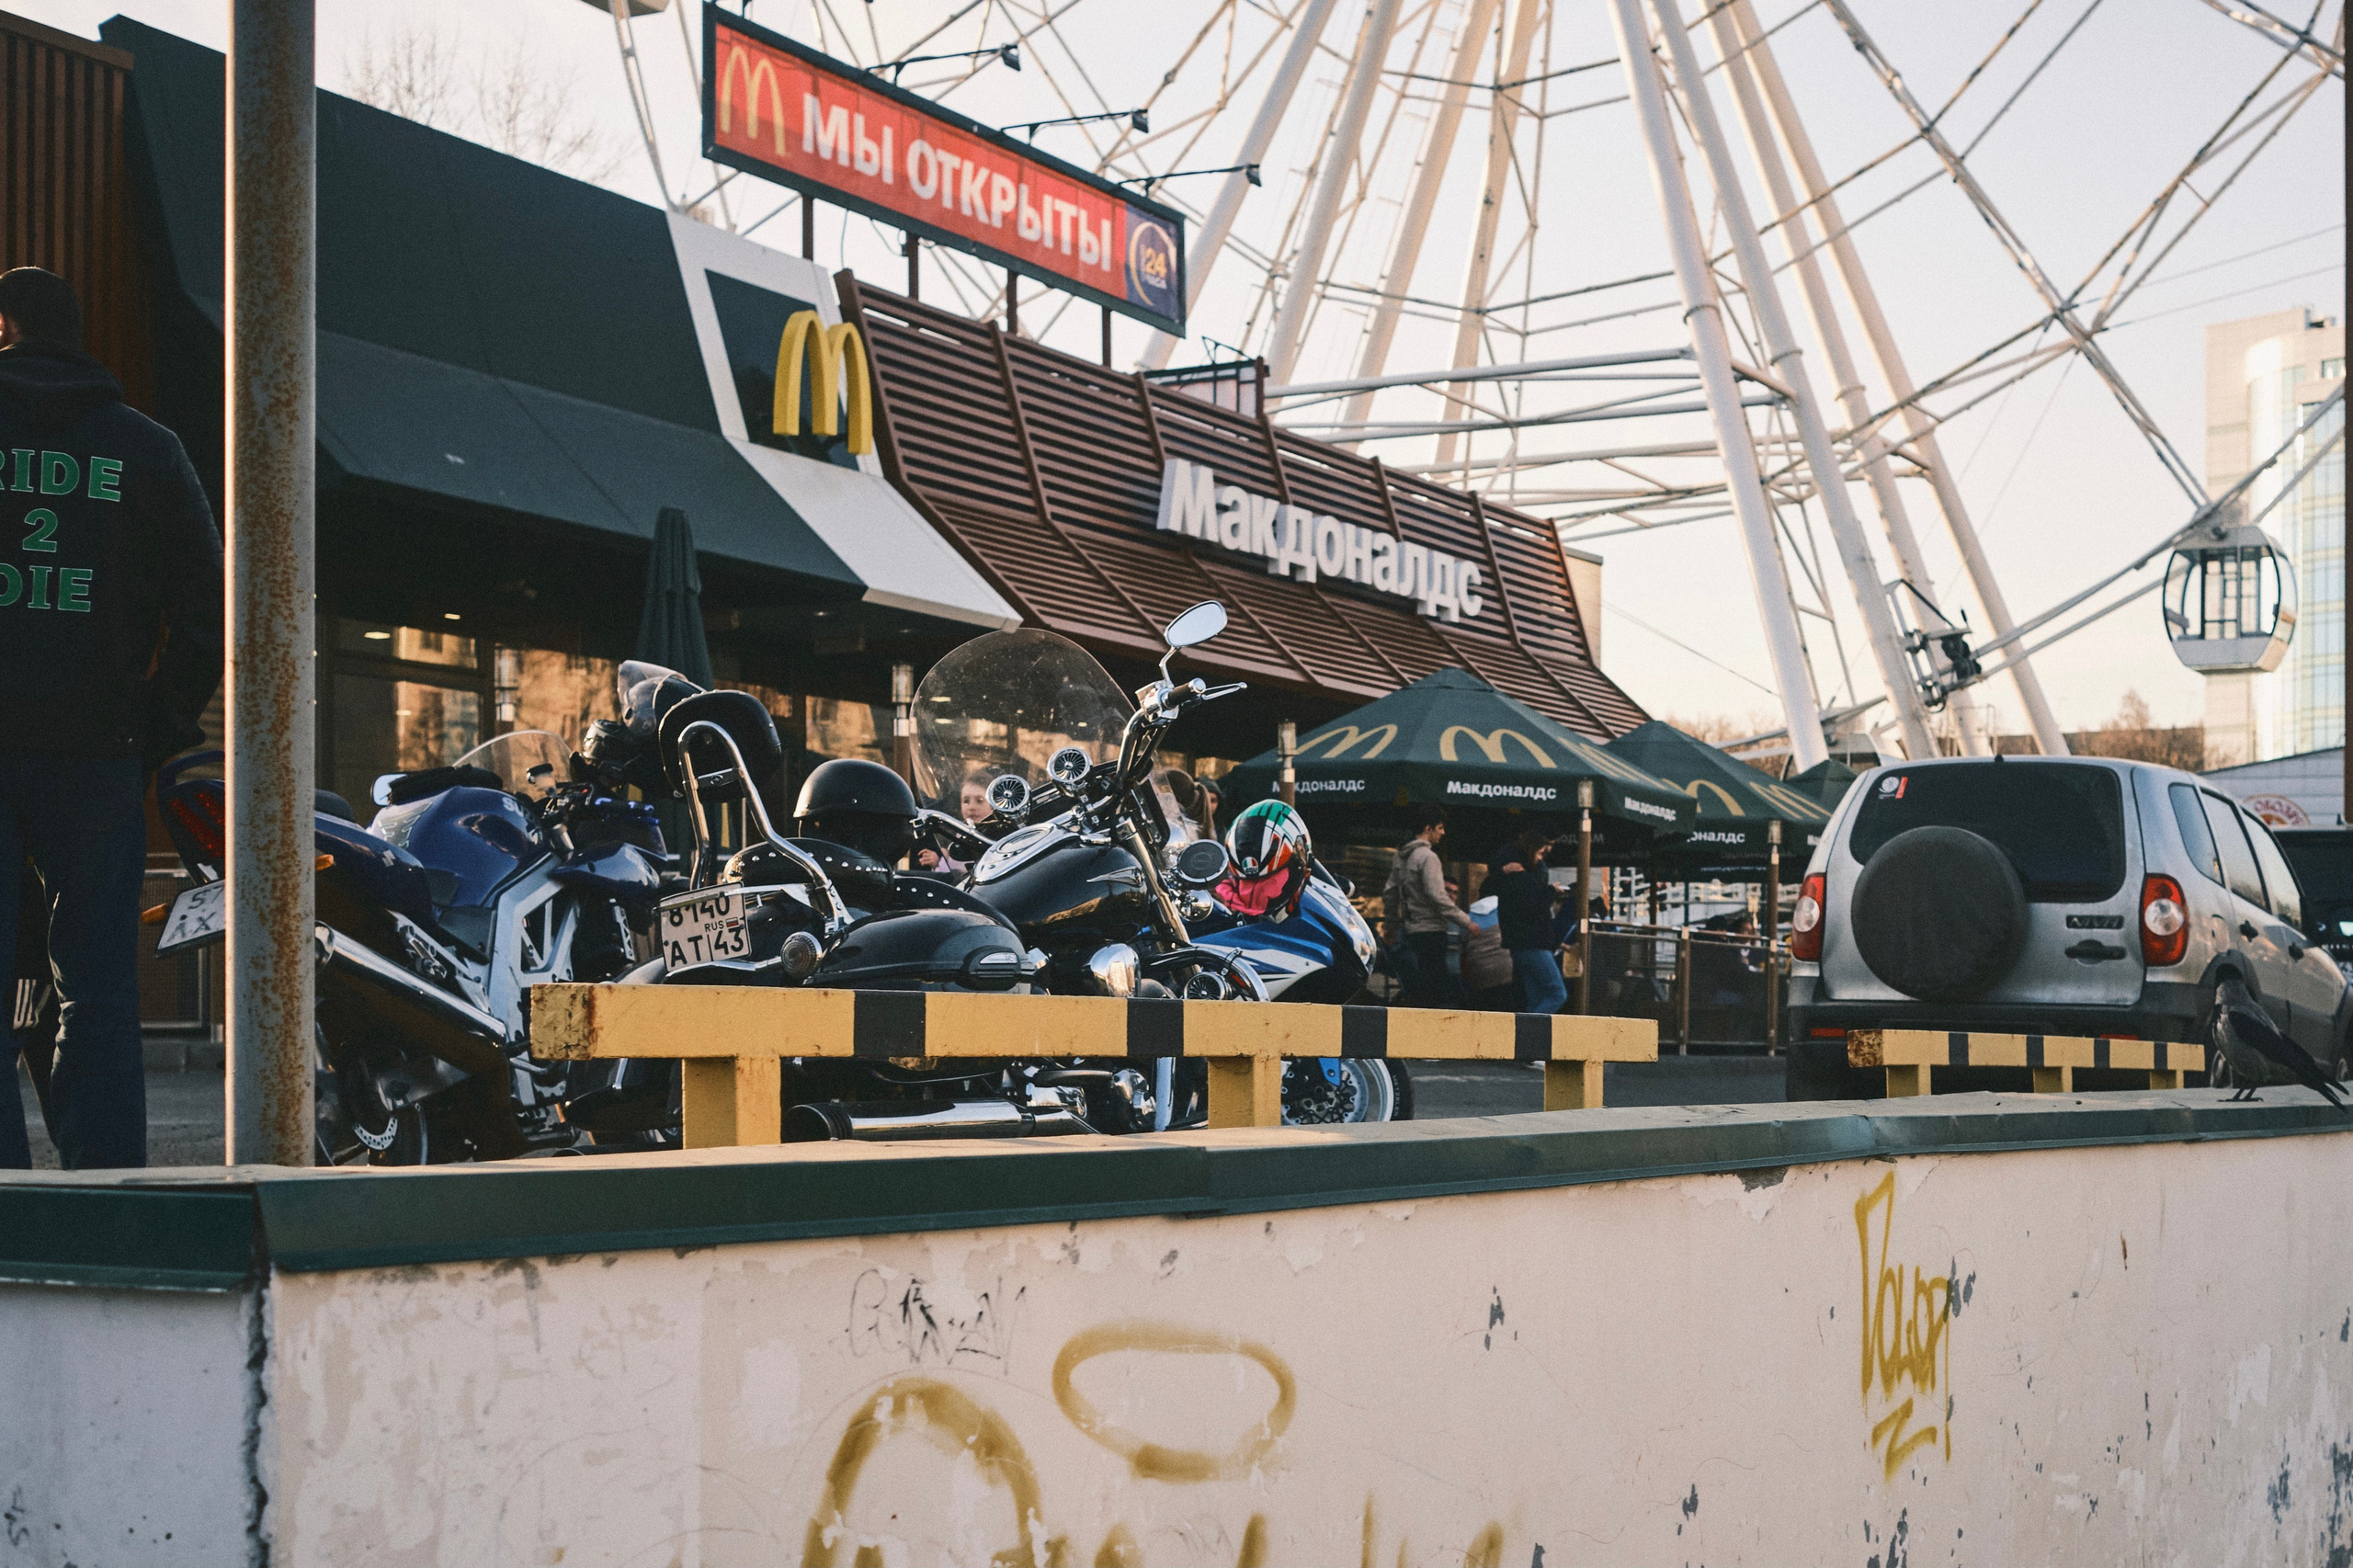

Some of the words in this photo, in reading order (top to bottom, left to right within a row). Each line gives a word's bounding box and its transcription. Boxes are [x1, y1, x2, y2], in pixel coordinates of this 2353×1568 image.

[802, 92, 894, 185] МЫ
[906, 139, 1112, 273] ОТКРЫТЫ
[1144, 247, 1167, 278] 24
[0, 449, 123, 502] IDE
[22, 507, 58, 552] 2
[1156, 459, 1483, 623] Макдоналдс
[1271, 779, 1366, 793] Мкдоналдс
[1447, 780, 1557, 801] Макдоналдс
[1624, 796, 1677, 822] Макдоналдс
[1687, 831, 1745, 845] оналдс
[669, 894, 730, 927] 8140
[704, 920, 724, 933] RUS
[713, 926, 744, 955] 43
